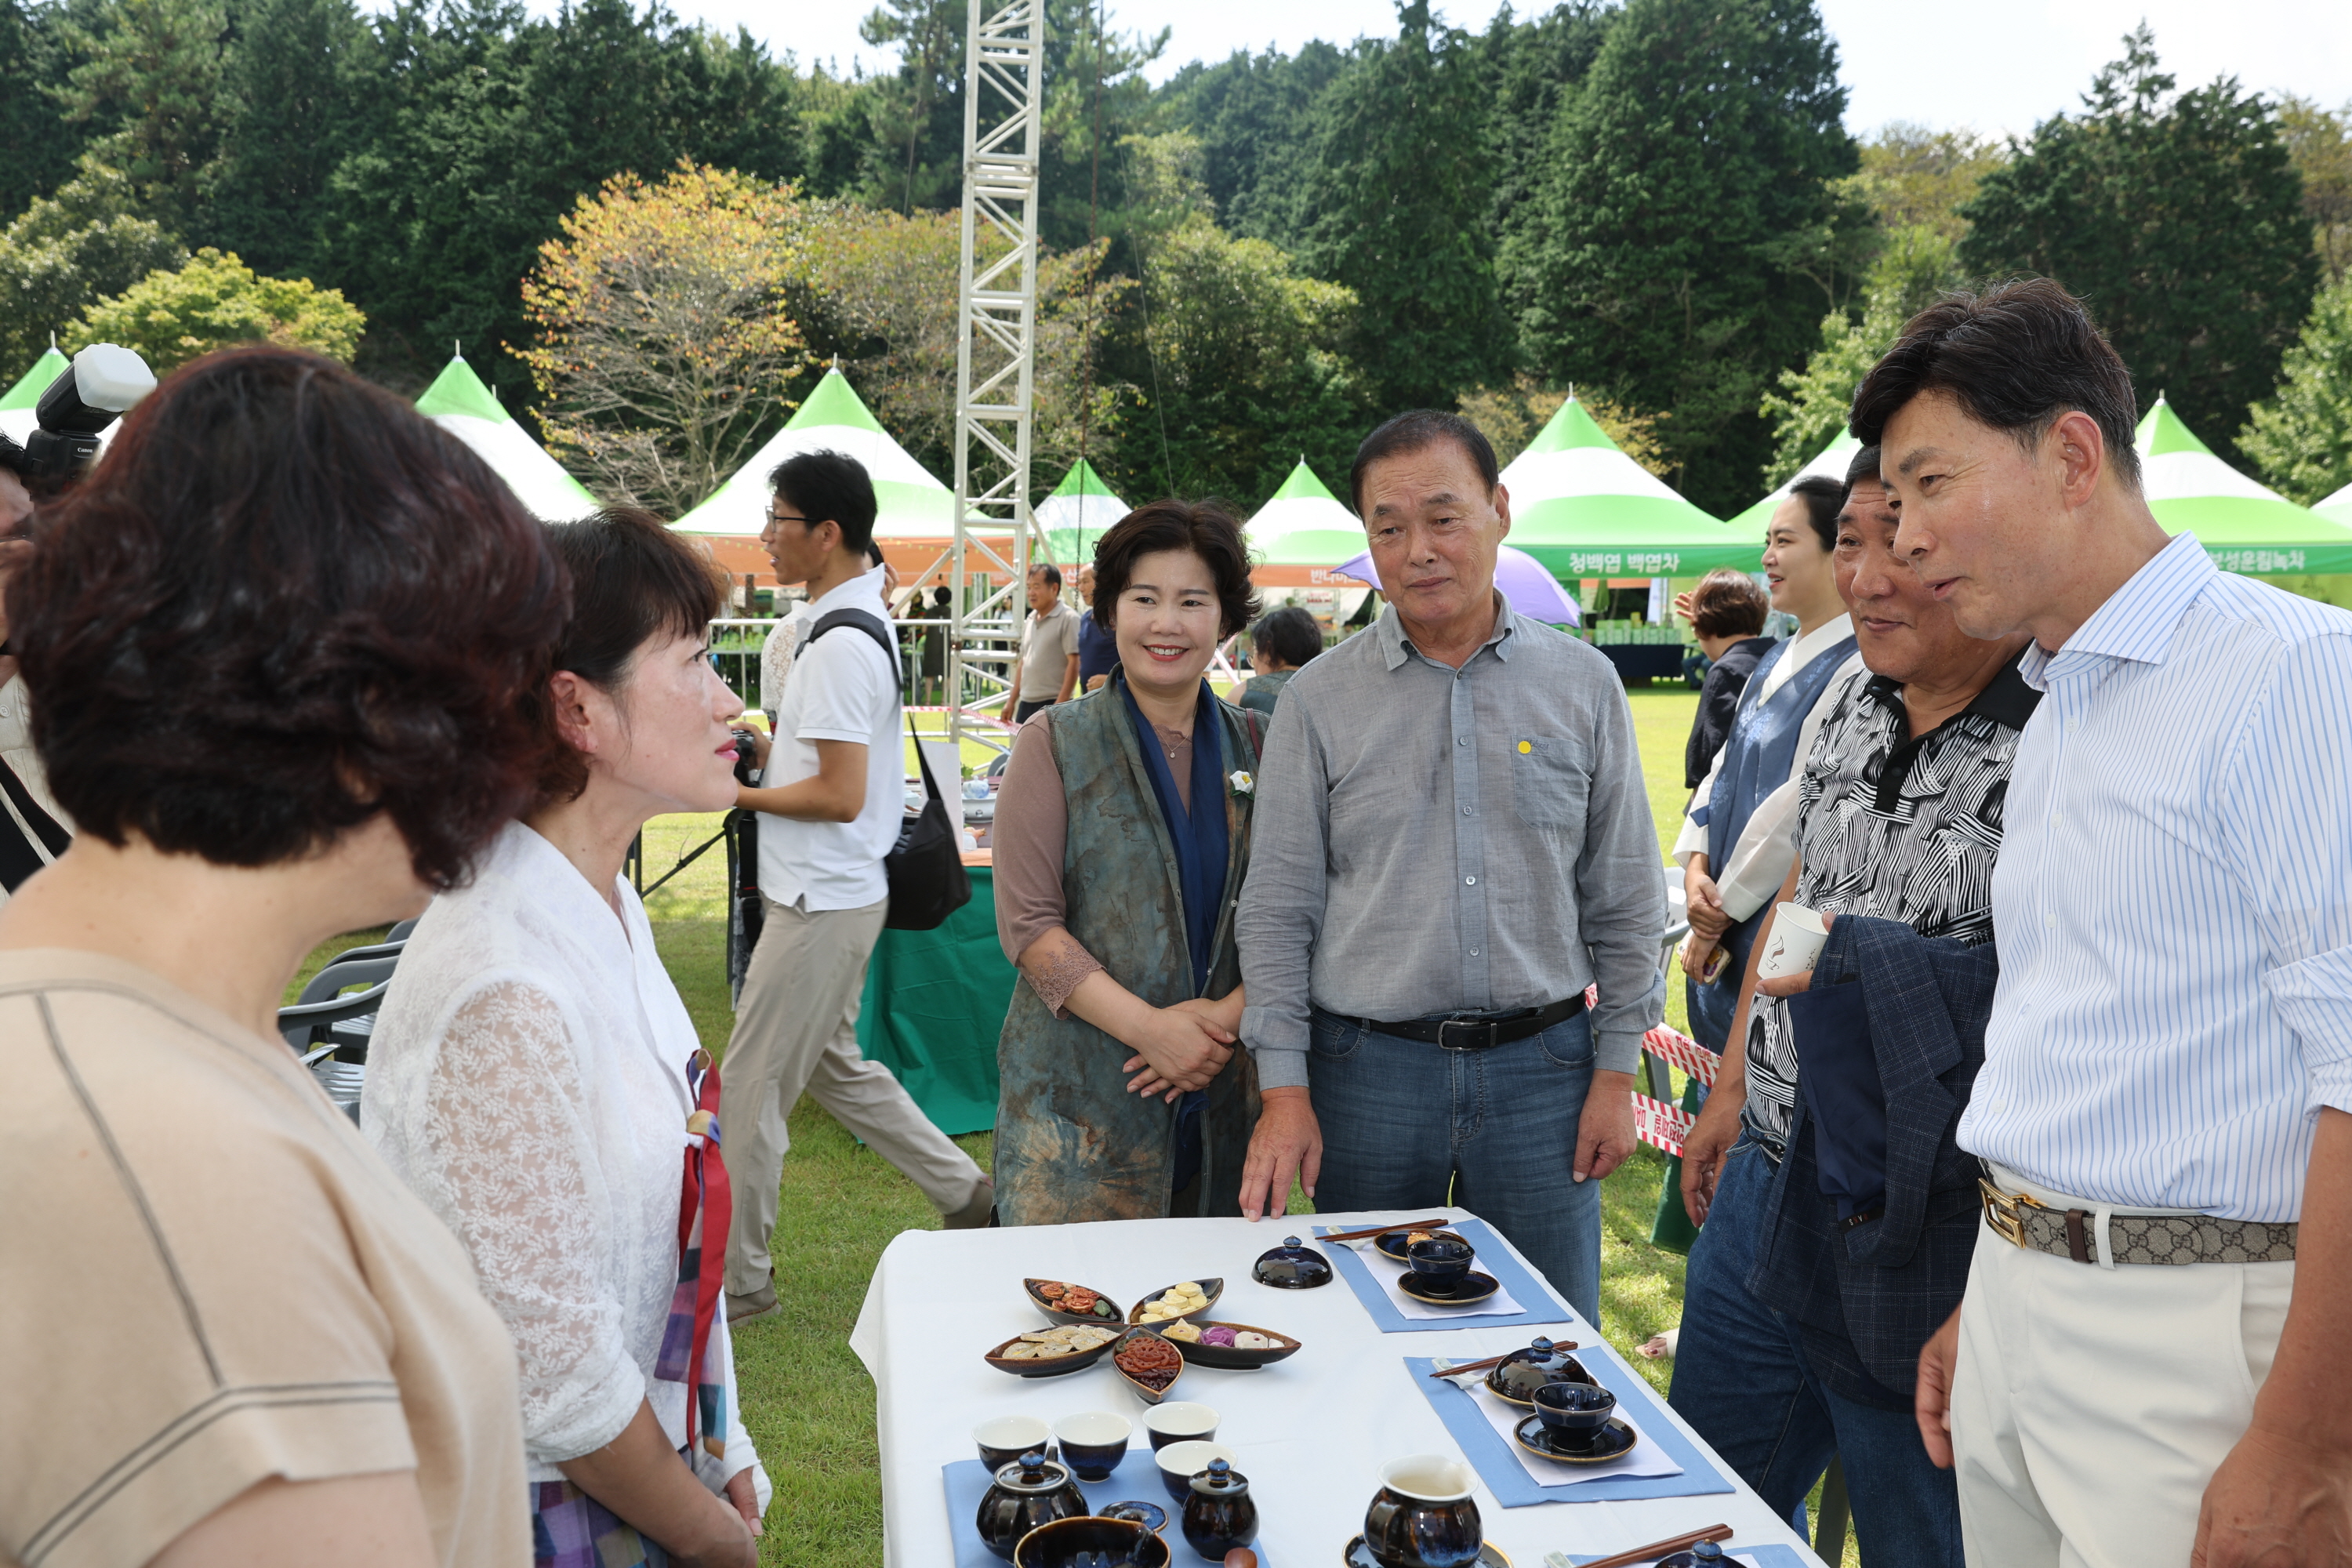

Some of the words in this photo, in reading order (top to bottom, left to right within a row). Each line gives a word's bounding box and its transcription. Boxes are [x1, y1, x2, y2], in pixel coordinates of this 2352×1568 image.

[1569, 552, 1621, 574] 청백엽
[1627, 552, 1680, 574] 백엽차
[1310, 568, 1360, 584] 반나미
[1653, 1113, 1685, 1145] 안전제일
